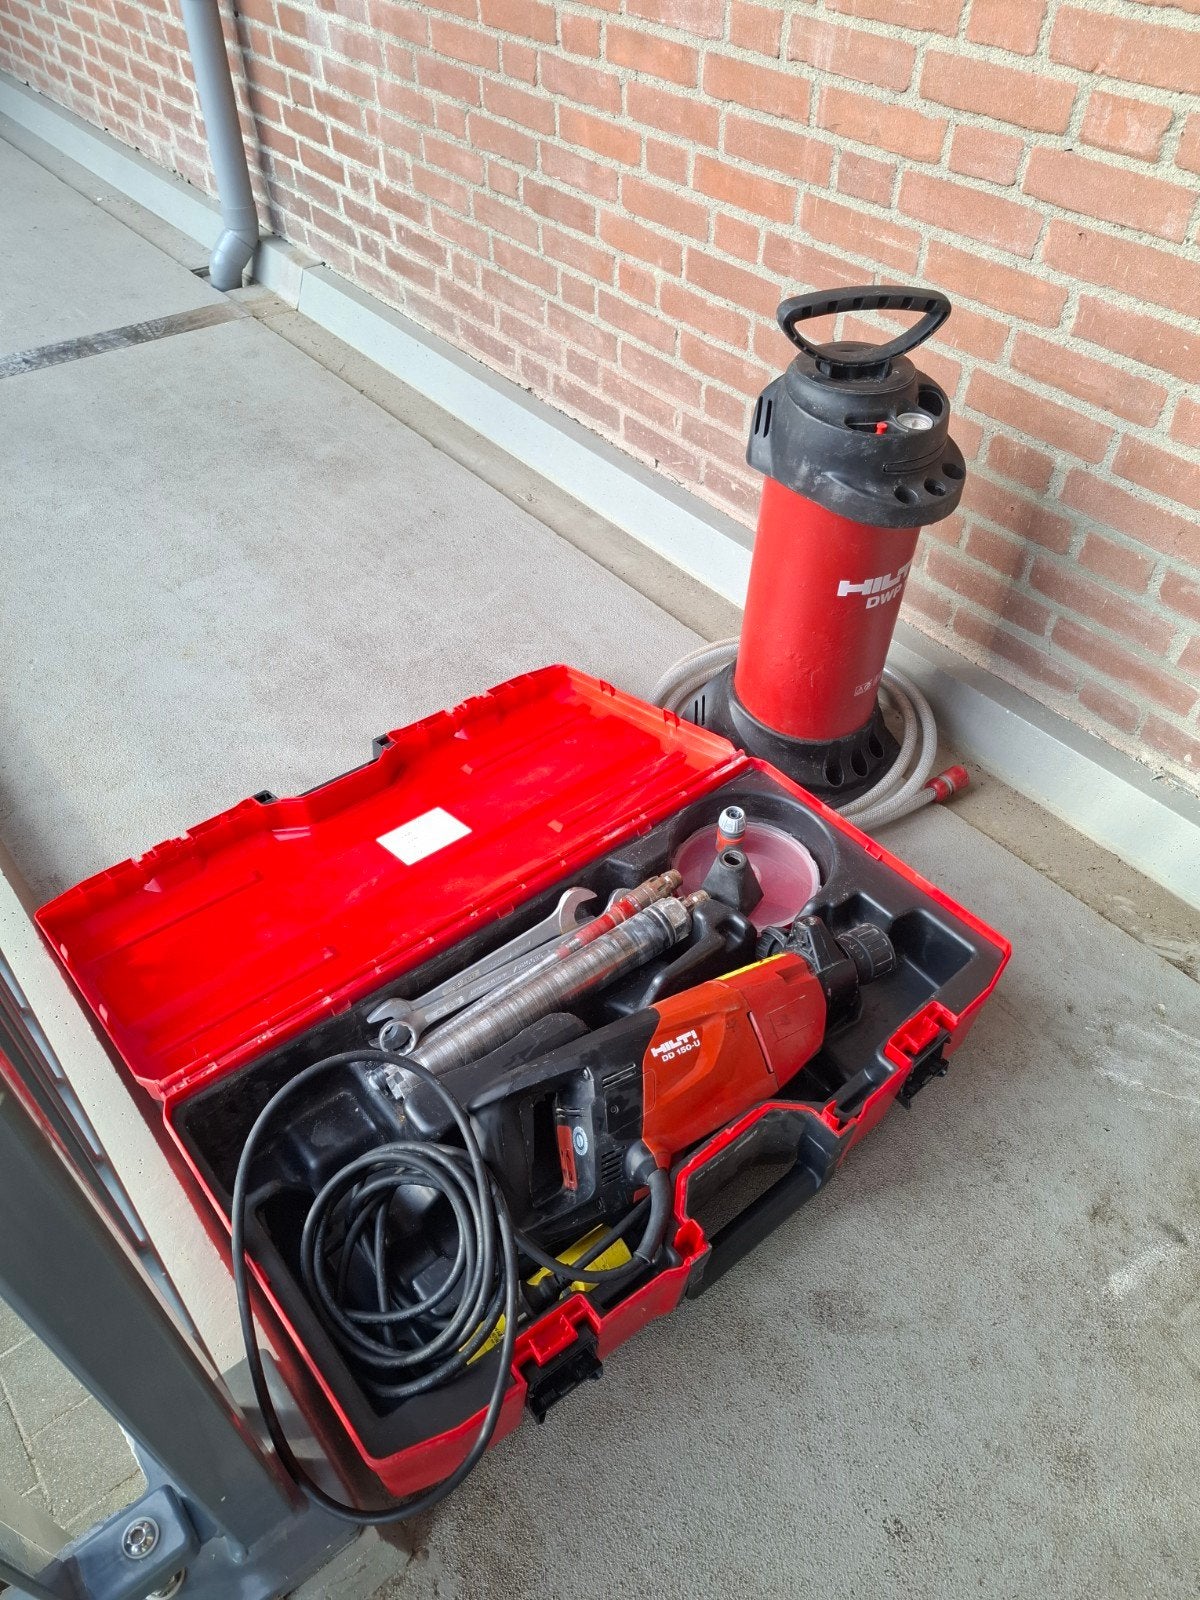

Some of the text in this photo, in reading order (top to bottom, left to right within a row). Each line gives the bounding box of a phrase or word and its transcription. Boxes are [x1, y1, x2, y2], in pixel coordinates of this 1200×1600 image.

[837, 560, 912, 597] HILT
[865, 584, 902, 609] DWP
[650, 1029, 698, 1058] HILTI
[661, 1039, 701, 1062] DD 150-U
